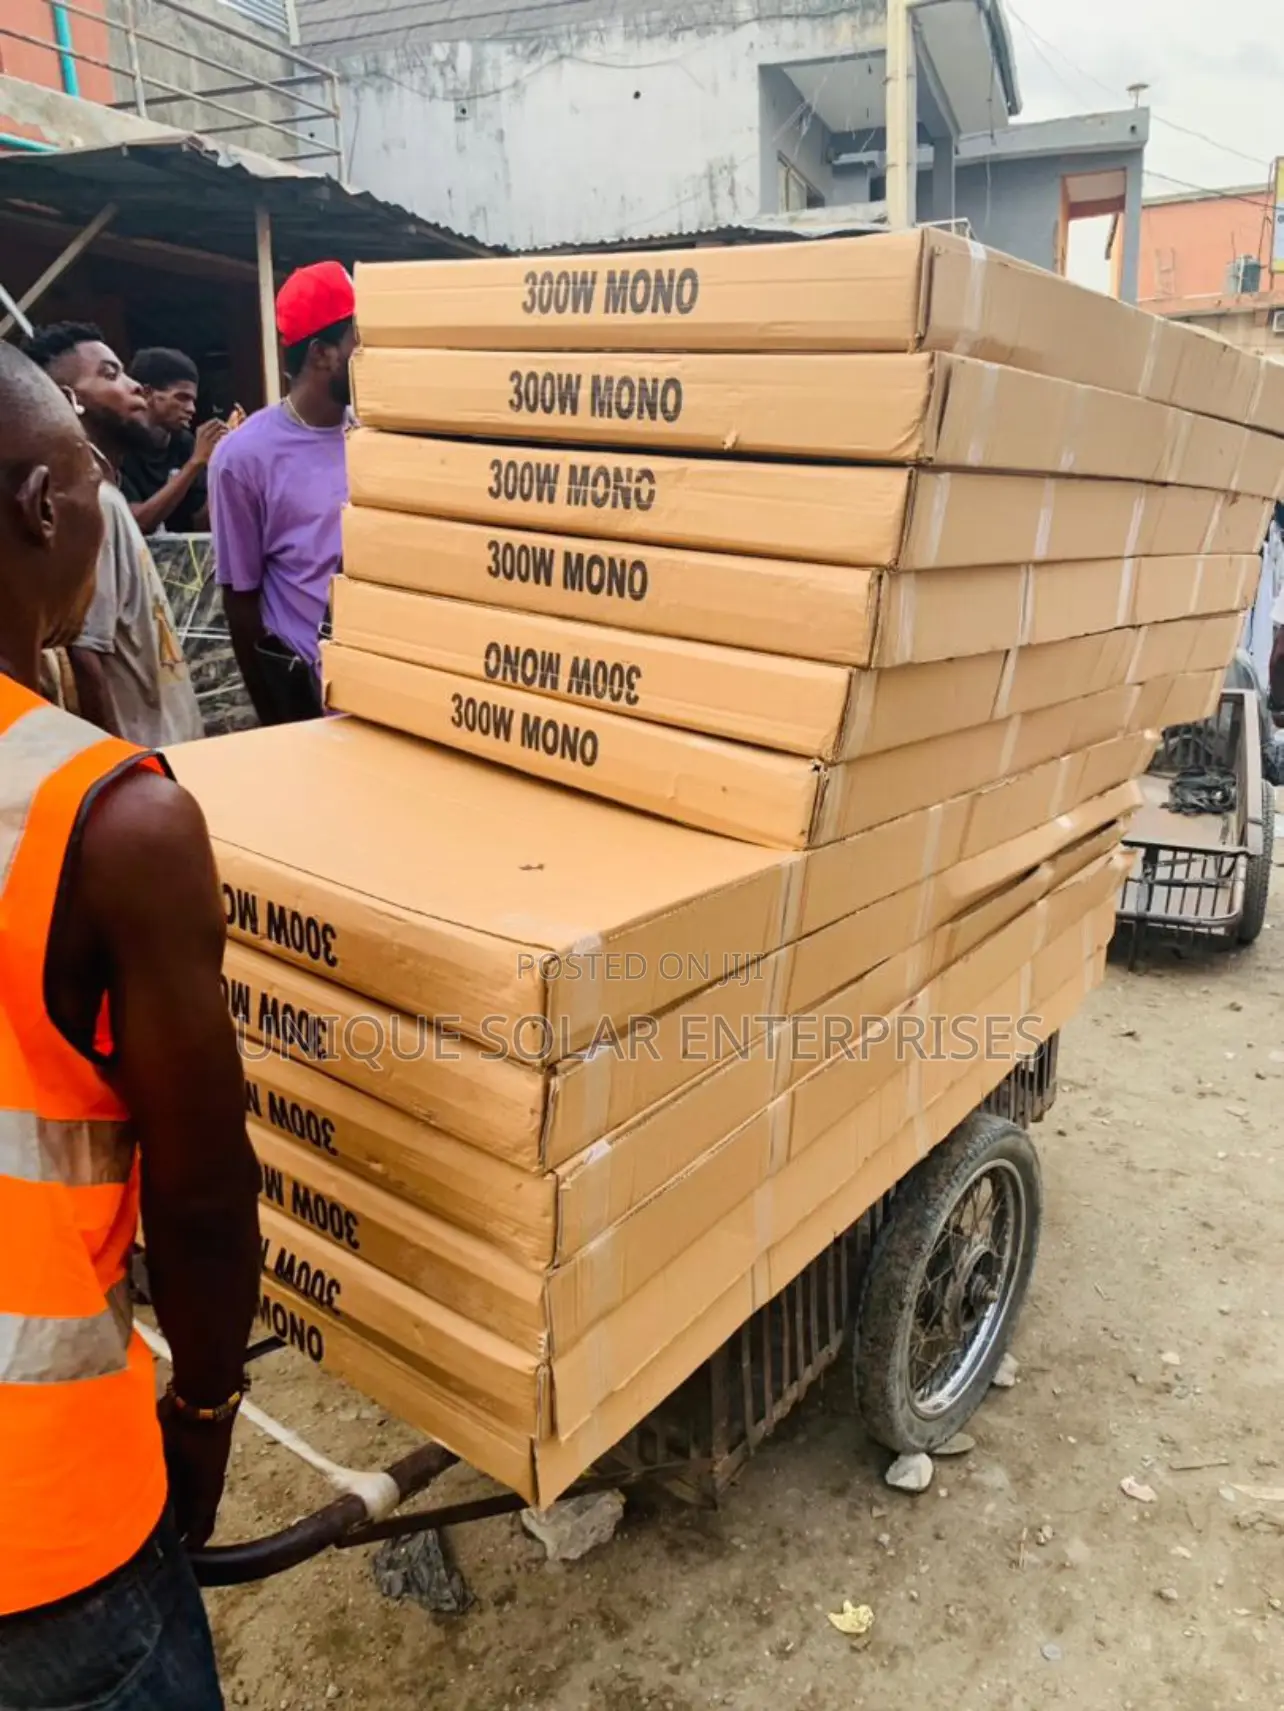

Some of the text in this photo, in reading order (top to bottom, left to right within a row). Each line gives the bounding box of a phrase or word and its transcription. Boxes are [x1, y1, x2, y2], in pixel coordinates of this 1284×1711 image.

[522, 267, 699, 315] 300W MONO
[508, 370, 683, 422] 300W MONO
[488, 459, 657, 512] 300W MONO
[486, 540, 649, 601] 300W MONO
[484, 641, 642, 706] 300W MONO
[450, 692, 599, 767] 300W MONO
[266, 900, 339, 968] 300W
[258, 991, 327, 1060] 300W
[267, 1090, 339, 1157] 300W
[291, 1179, 360, 1250] 300W
[273, 1247, 342, 1317] 300W
